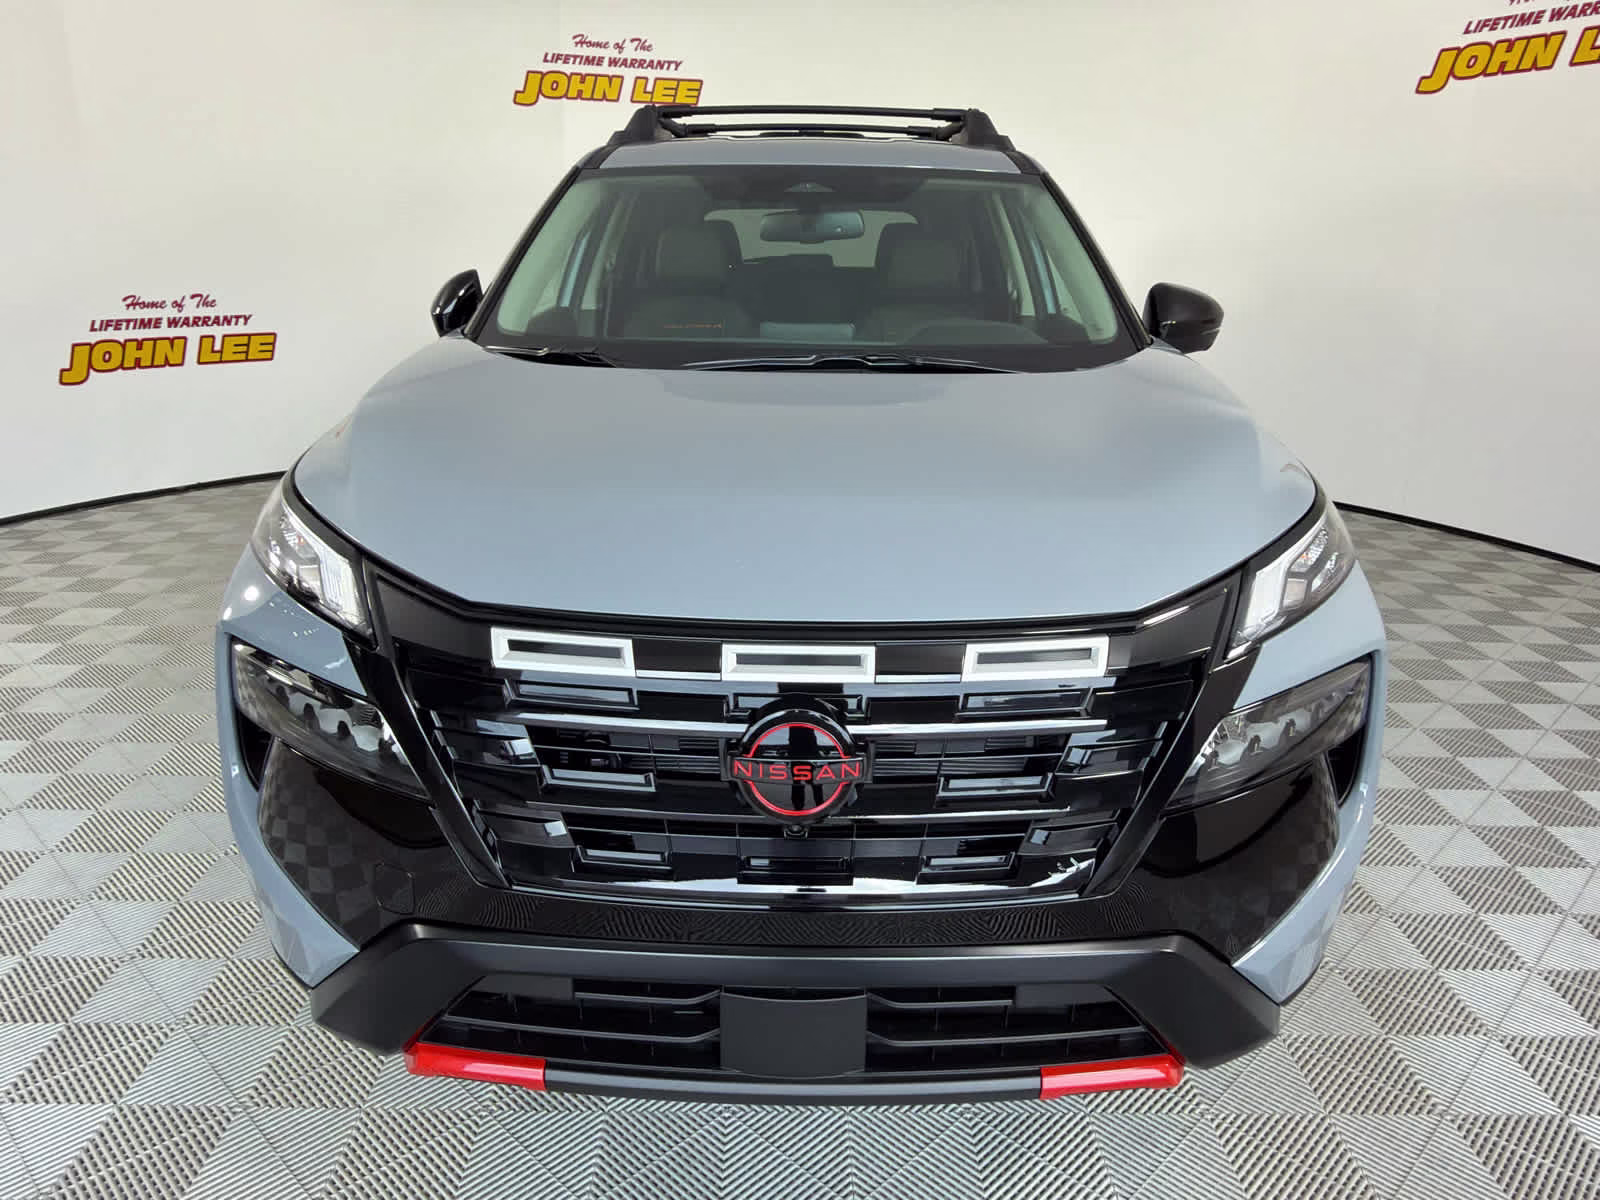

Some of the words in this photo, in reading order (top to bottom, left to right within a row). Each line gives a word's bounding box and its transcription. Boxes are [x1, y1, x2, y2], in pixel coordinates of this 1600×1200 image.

[1463, 9, 1547, 35] LIFETIME
[572, 33, 609, 50] Home
[612, 36, 626, 54] of
[630, 37, 653, 53] The
[542, 52, 605, 68] LIFETIME
[607, 56, 682, 72] WARRANTY
[1415, 31, 1567, 94] JOHN
[513, 70, 624, 106] JOHN
[630, 76, 703, 105] LEE
[122, 294, 167, 310] Home
[171, 295, 185, 312] of
[190, 293, 217, 309] The
[89, 316, 163, 332] LIFETIME
[166, 313, 252, 328] WARRANTY
[59, 336, 187, 386] JOHN
[196, 332, 277, 365] LEE
[734, 761, 860, 781] NISSAN
